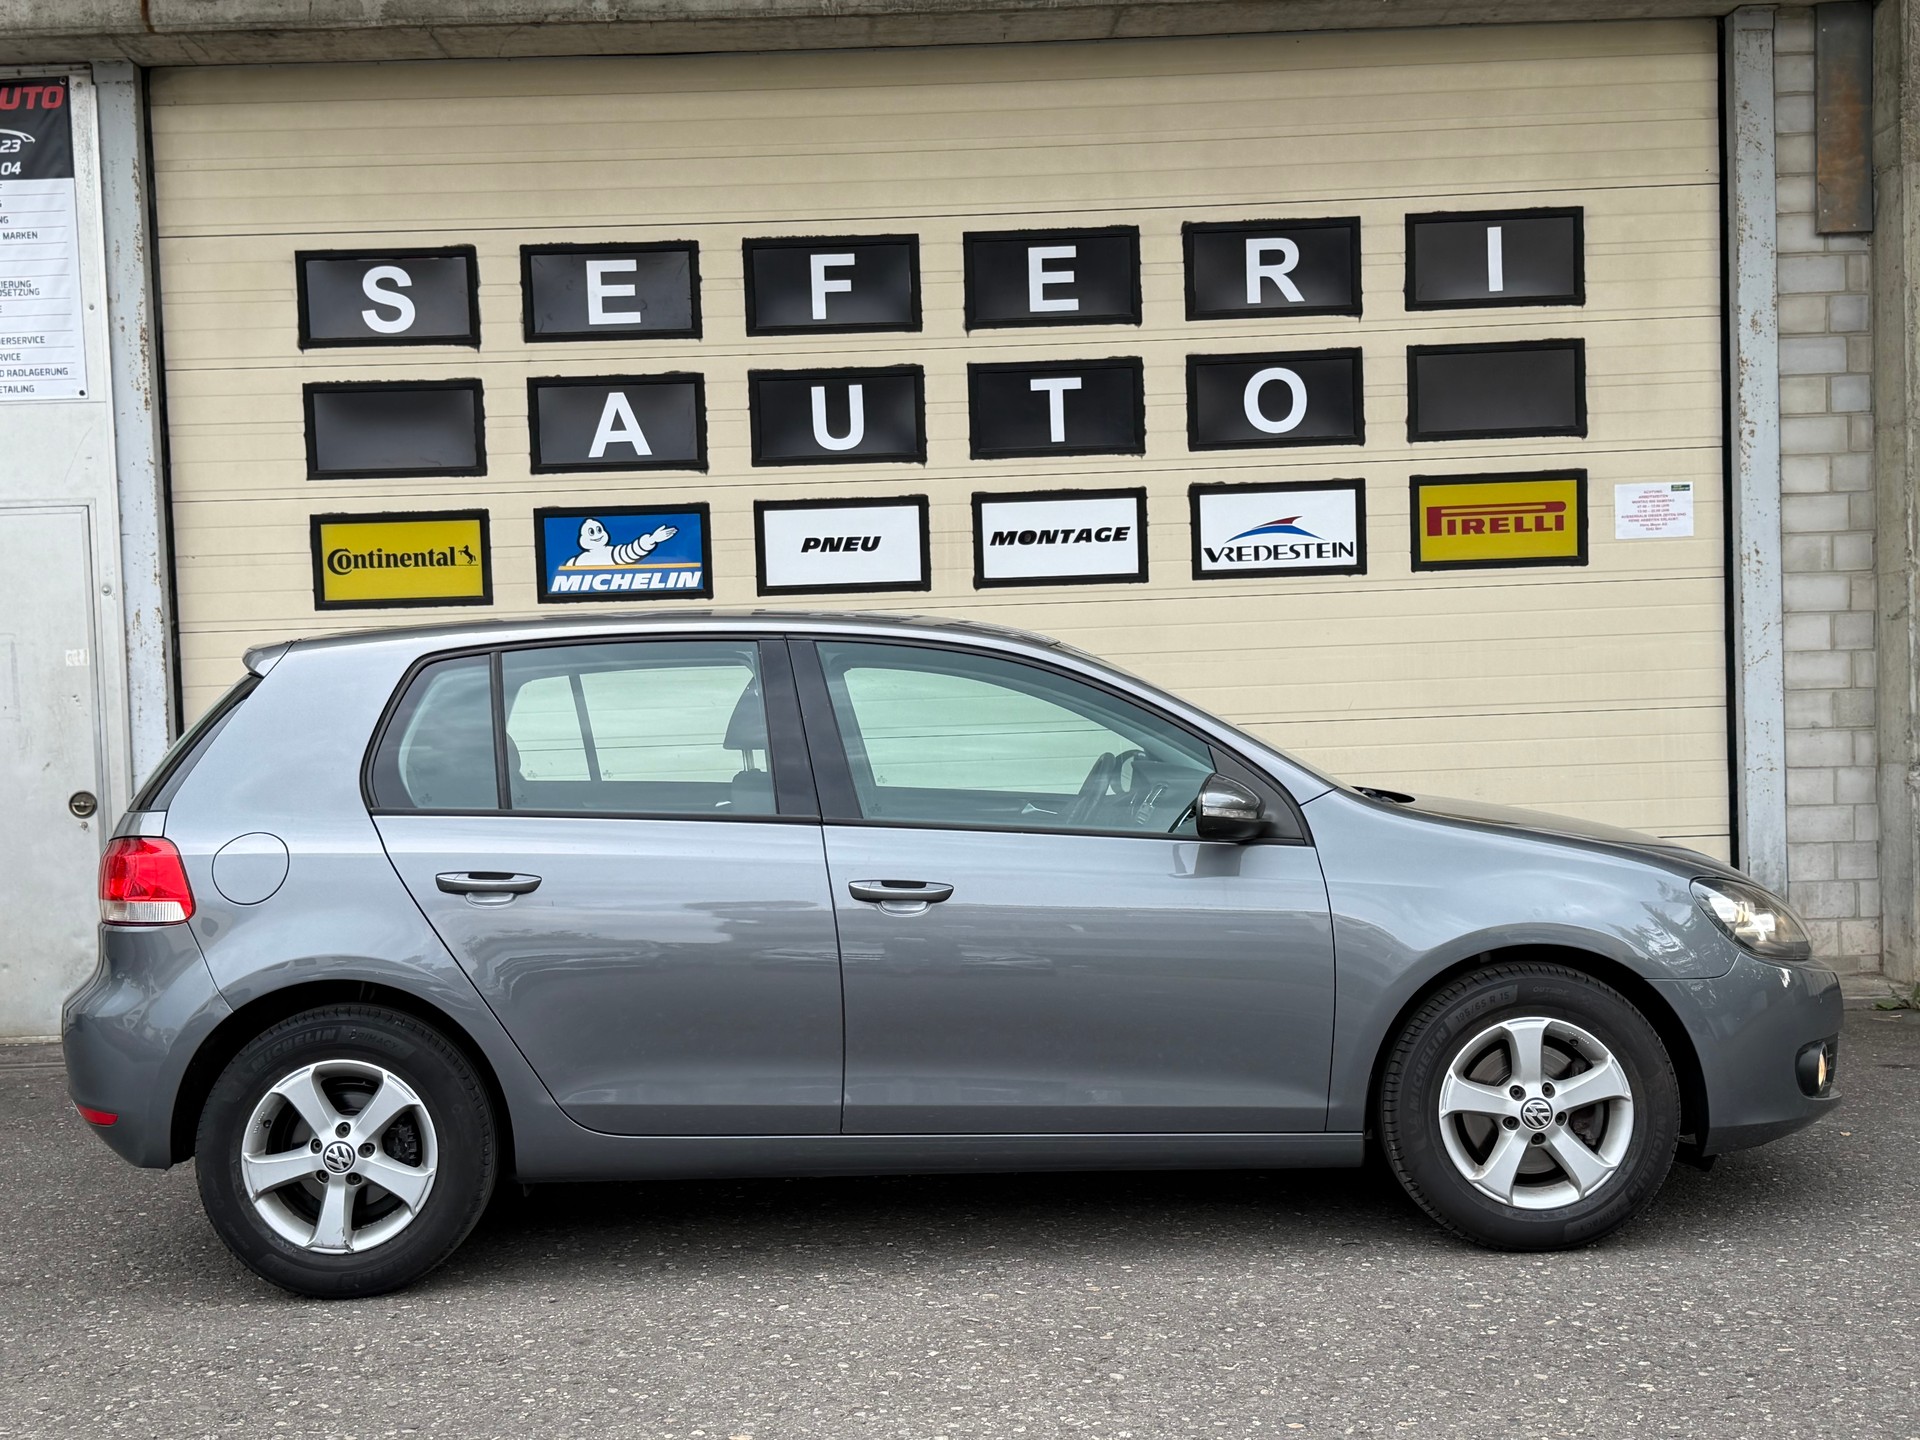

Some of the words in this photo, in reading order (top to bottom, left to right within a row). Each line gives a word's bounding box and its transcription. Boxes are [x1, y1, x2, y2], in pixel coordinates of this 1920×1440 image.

[1, 161, 21, 175] 04
[2, 231, 38, 240] MARKEN
[7, 367, 68, 378] RADLAGERUNG
[1427, 501, 1567, 537] PIRELLI
[800, 535, 882, 553] PNEU
[989, 526, 1131, 547] MONTAGE
[327, 546, 457, 576] Continental
[1203, 541, 1354, 563] VREDESTEIN
[551, 571, 702, 592] MICHELIN
